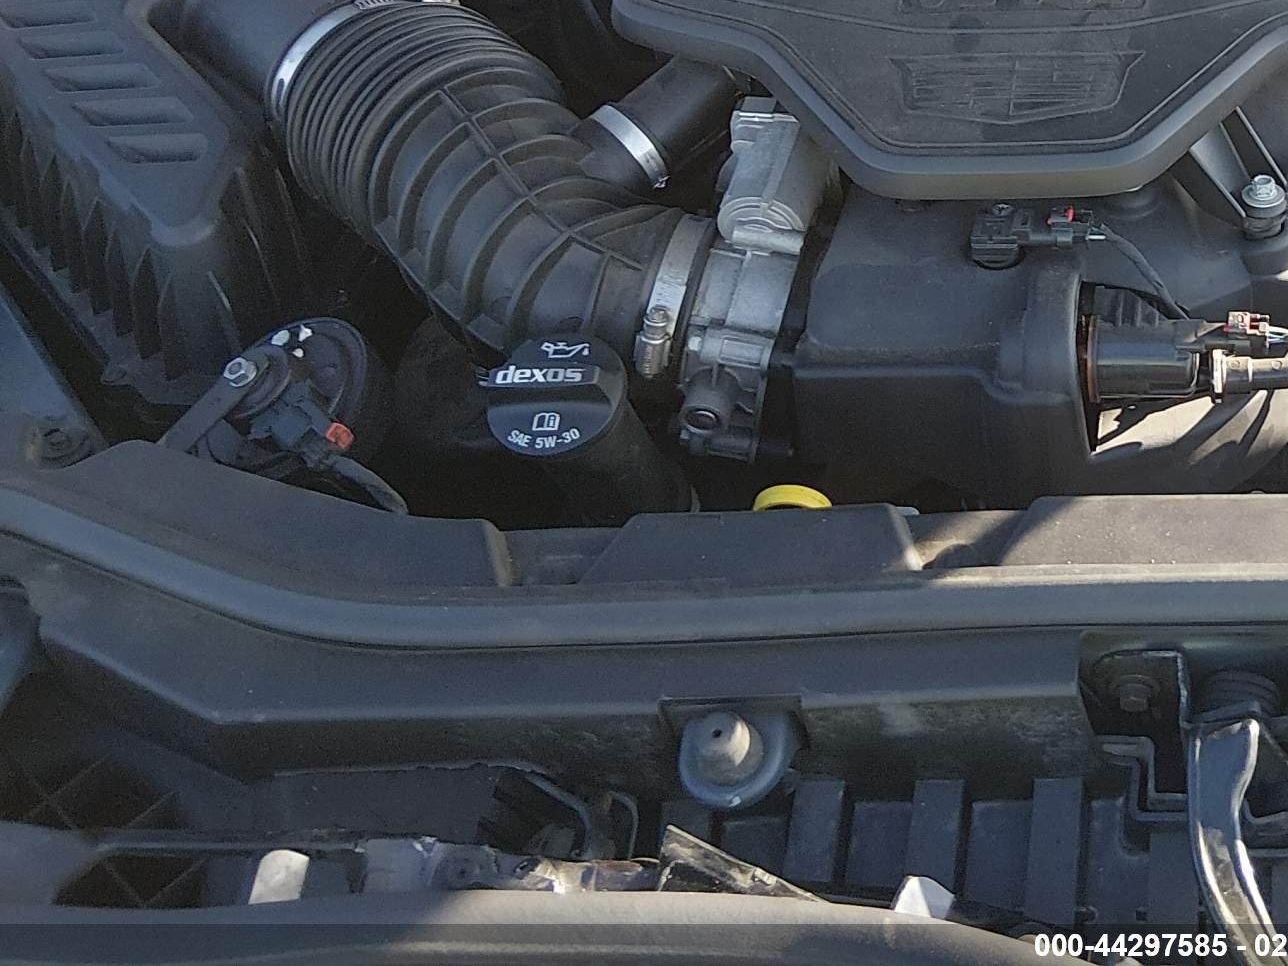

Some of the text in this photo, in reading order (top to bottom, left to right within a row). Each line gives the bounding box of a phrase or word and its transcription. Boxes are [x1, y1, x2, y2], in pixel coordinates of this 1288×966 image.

[495, 365, 586, 384] dexos
[507, 428, 580, 449] SAE 5W-30
